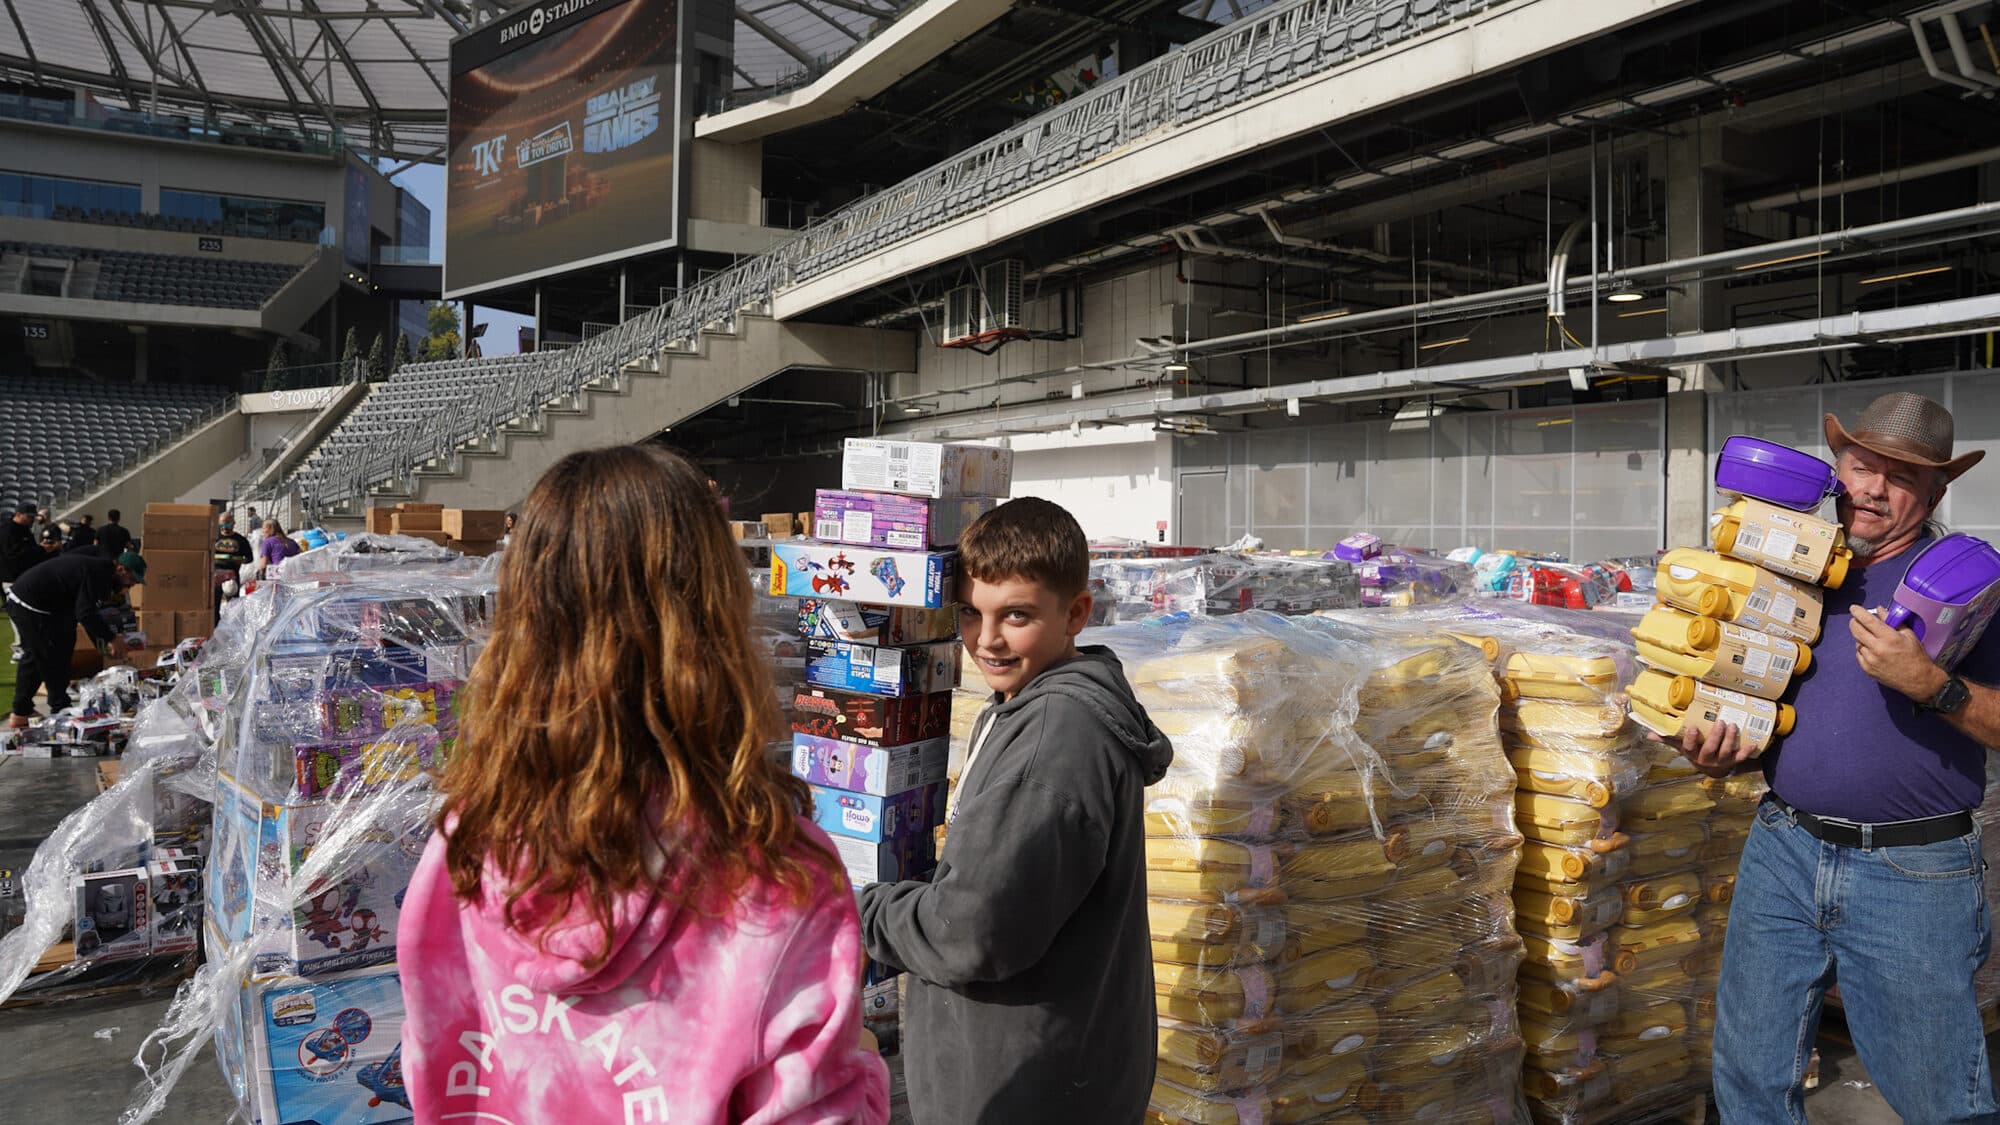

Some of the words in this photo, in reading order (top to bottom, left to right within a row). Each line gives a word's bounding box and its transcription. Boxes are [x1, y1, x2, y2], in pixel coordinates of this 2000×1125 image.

[500, 23, 528, 44] BMO
[472, 134, 507, 177] TKF
[201, 240, 221, 250] 235
[24, 326, 47, 338] 135
[287, 390, 332, 405] TOYOTA
[846, 811, 870, 824] emoji
